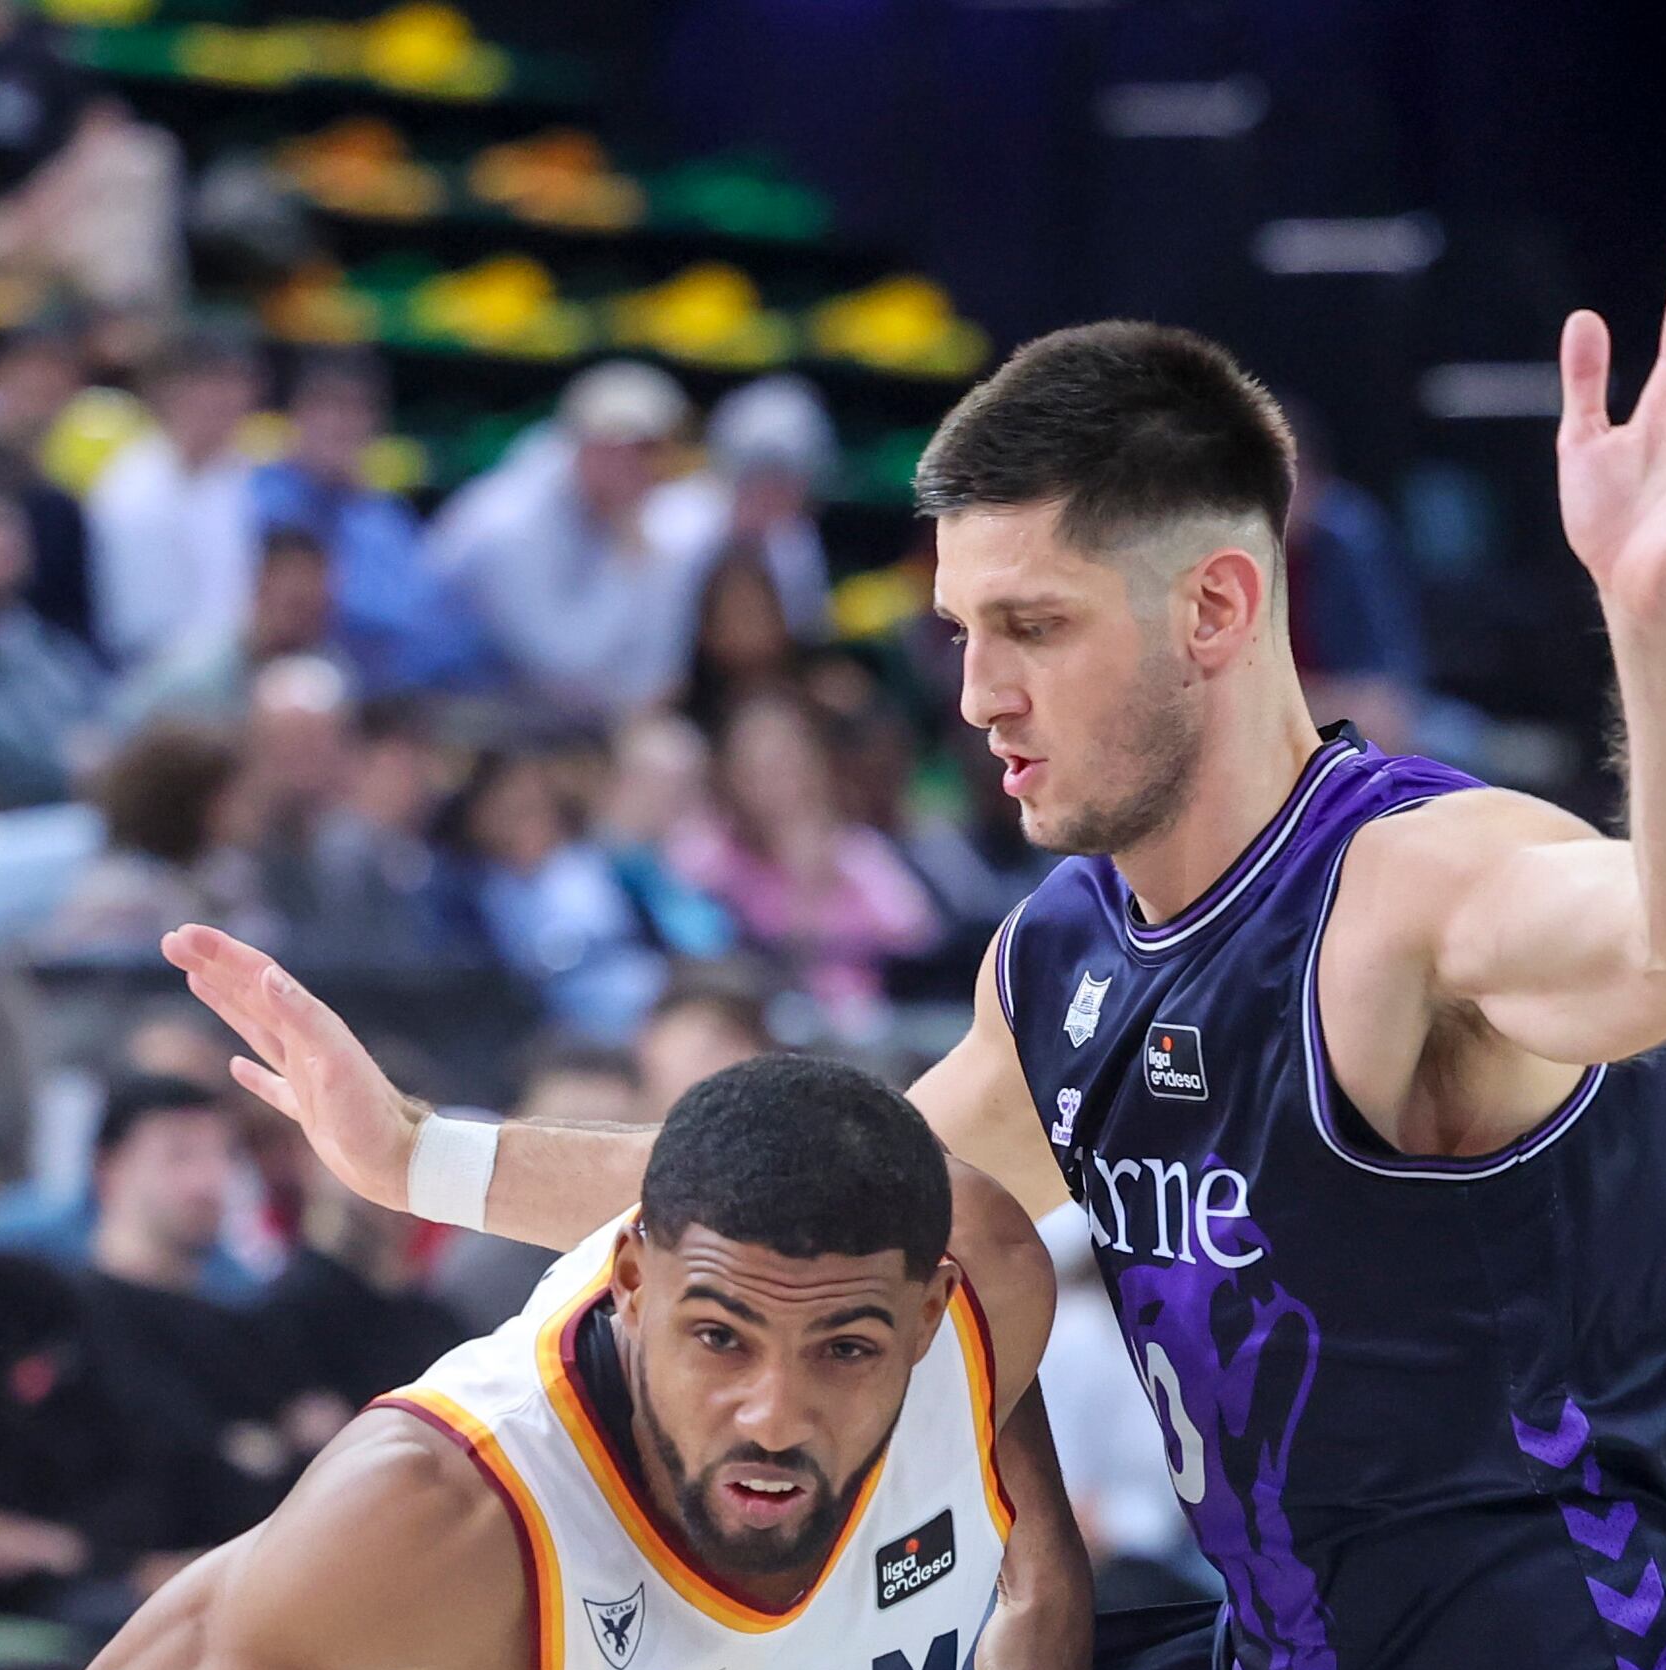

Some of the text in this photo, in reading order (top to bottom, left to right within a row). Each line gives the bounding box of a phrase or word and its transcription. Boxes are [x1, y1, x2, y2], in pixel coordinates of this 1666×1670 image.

[1148, 1046, 1171, 1069] liga
[1151, 1068, 1202, 1090] endesa
[882, 1554, 917, 1583] liga
[883, 1550, 952, 1600] endesa
